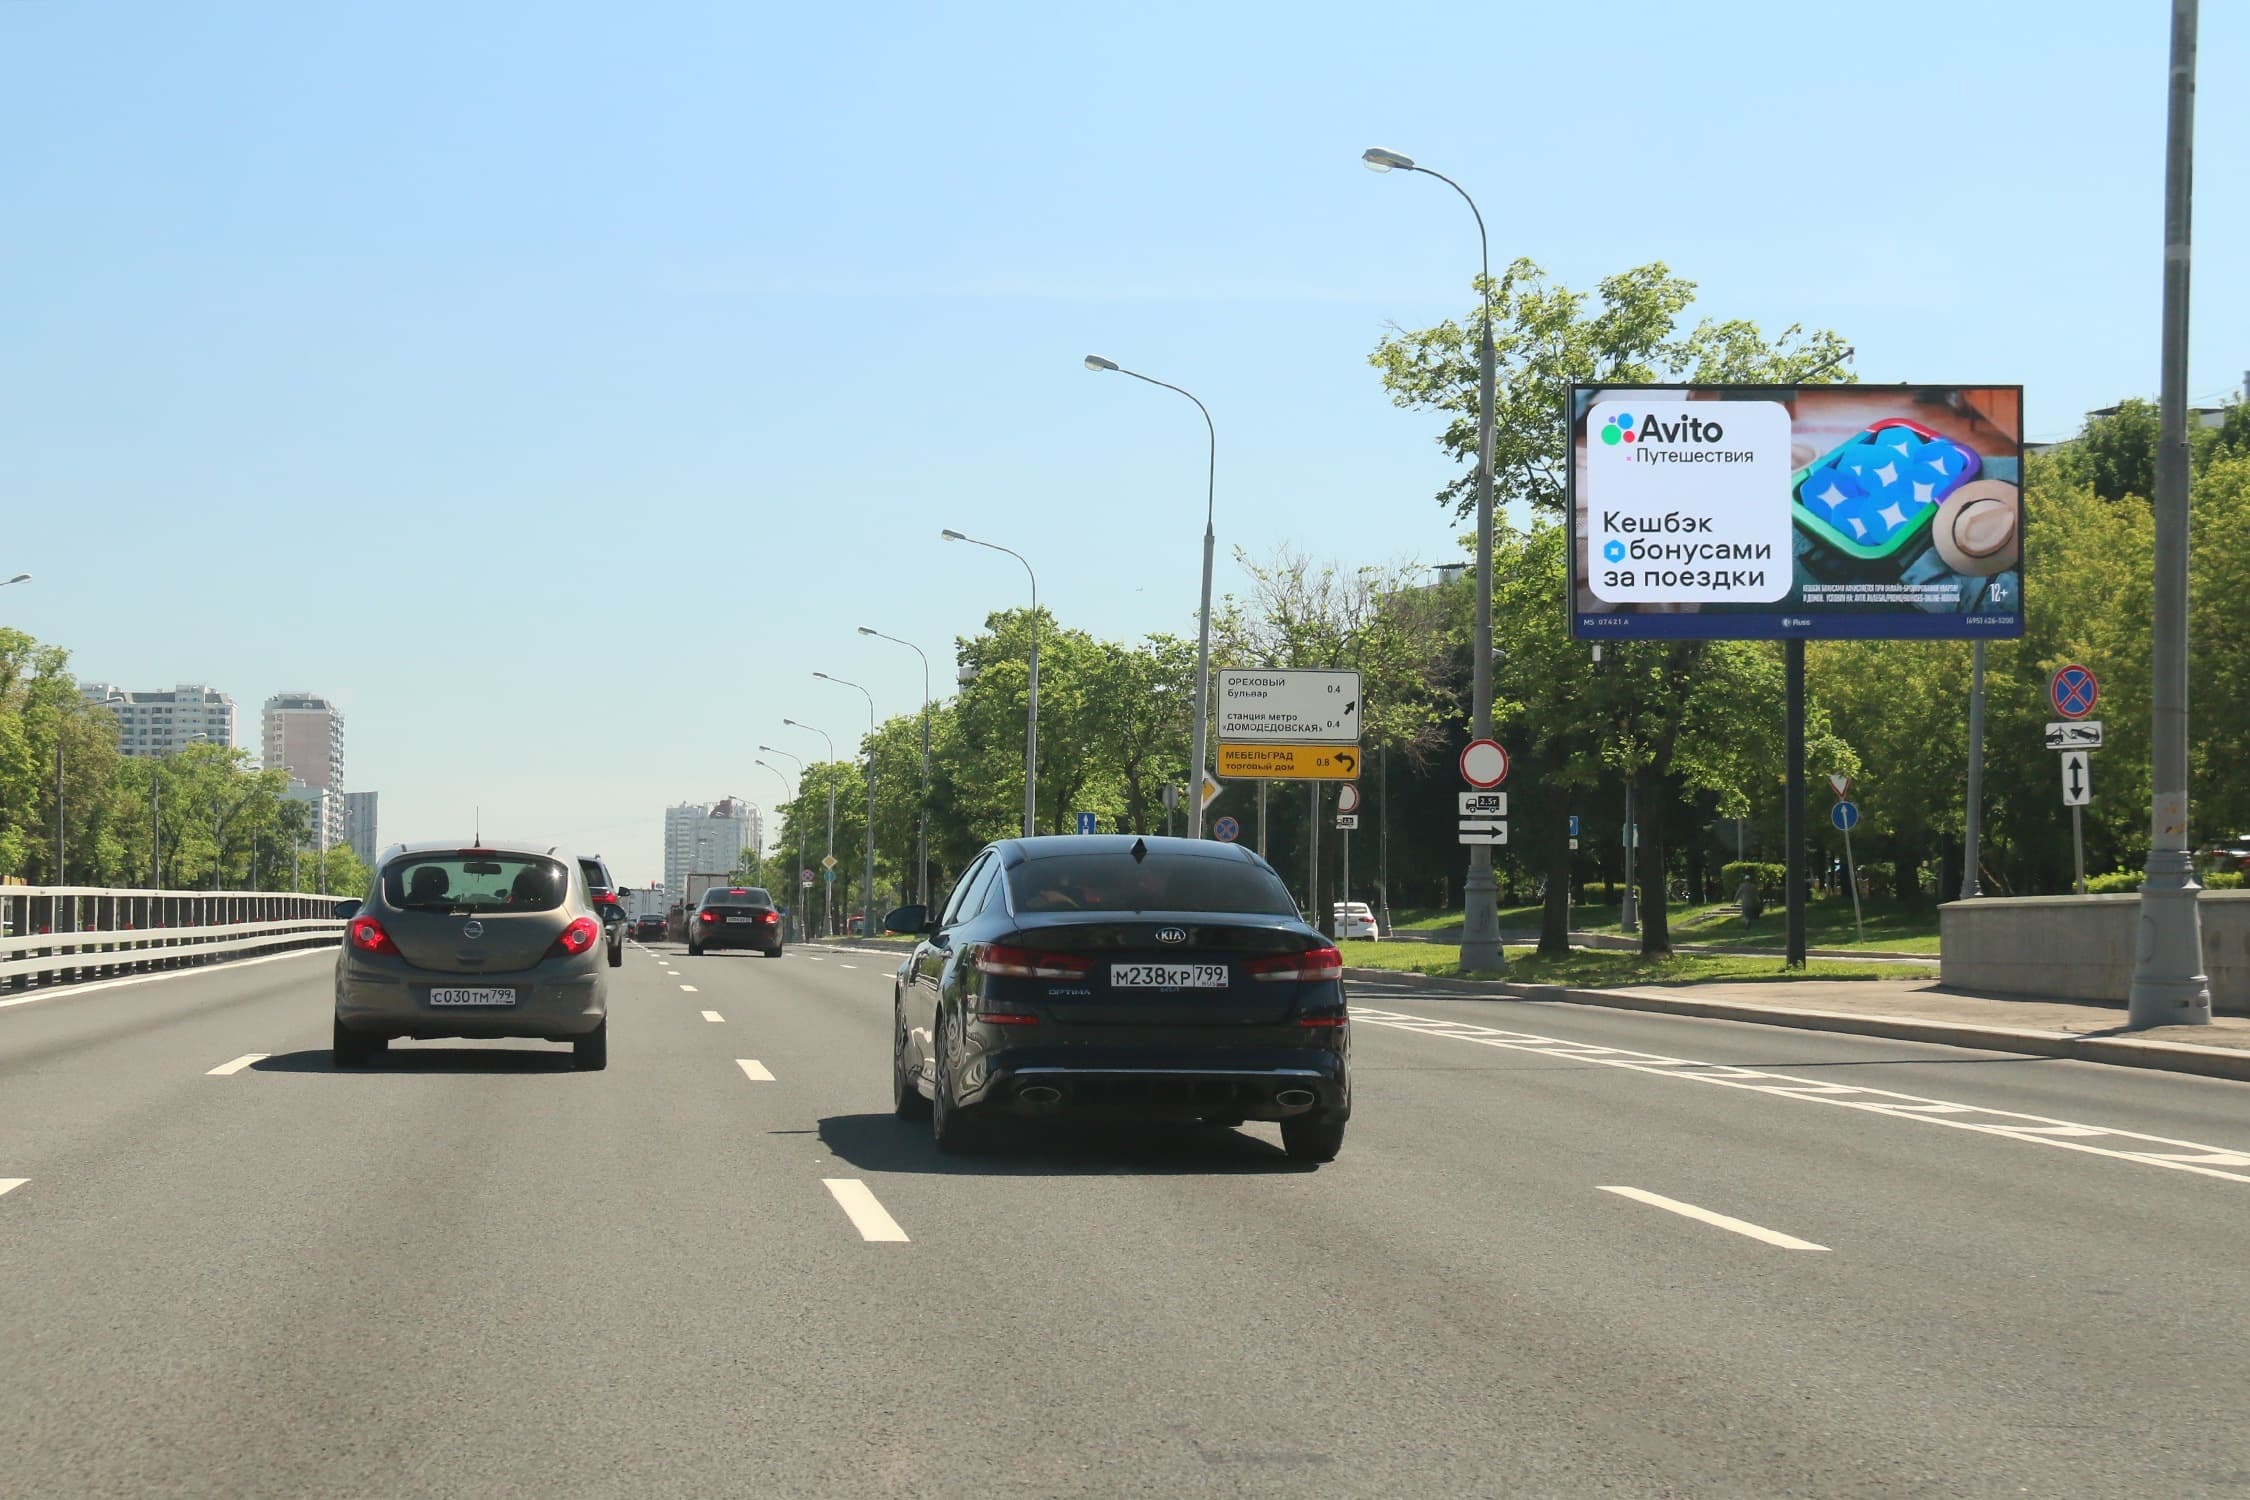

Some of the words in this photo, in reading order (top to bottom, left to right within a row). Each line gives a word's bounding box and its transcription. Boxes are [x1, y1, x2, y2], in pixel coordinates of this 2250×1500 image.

[1637, 414, 1724, 443] Avito
[1636, 447, 1754, 465] Путешествия
[1603, 511, 1713, 534] Кешбэк
[1630, 538, 1771, 565] бонусами
[1603, 571, 1635, 587] за
[1644, 571, 1765, 591] поездки
[1989, 583, 2008, 602] 12+
[1228, 677, 1285, 687] ОРЕХОВЫЙ
[1227, 689, 1268, 698] бульвар
[1327, 685, 1341, 693] 0.4
[1227, 713, 1266, 721] станция
[1268, 713, 1298, 722] метро
[1222, 723, 1323, 732] «ДОМОДЕДОВСКАЯ»
[1326, 720, 1340, 728] 0.4
[1225, 751, 1294, 761] МЕБЕЛЬГРАД
[1226, 763, 1272, 771] торговый
[1274, 763, 1295, 771] дом
[1160, 931, 1183, 942] KIA
